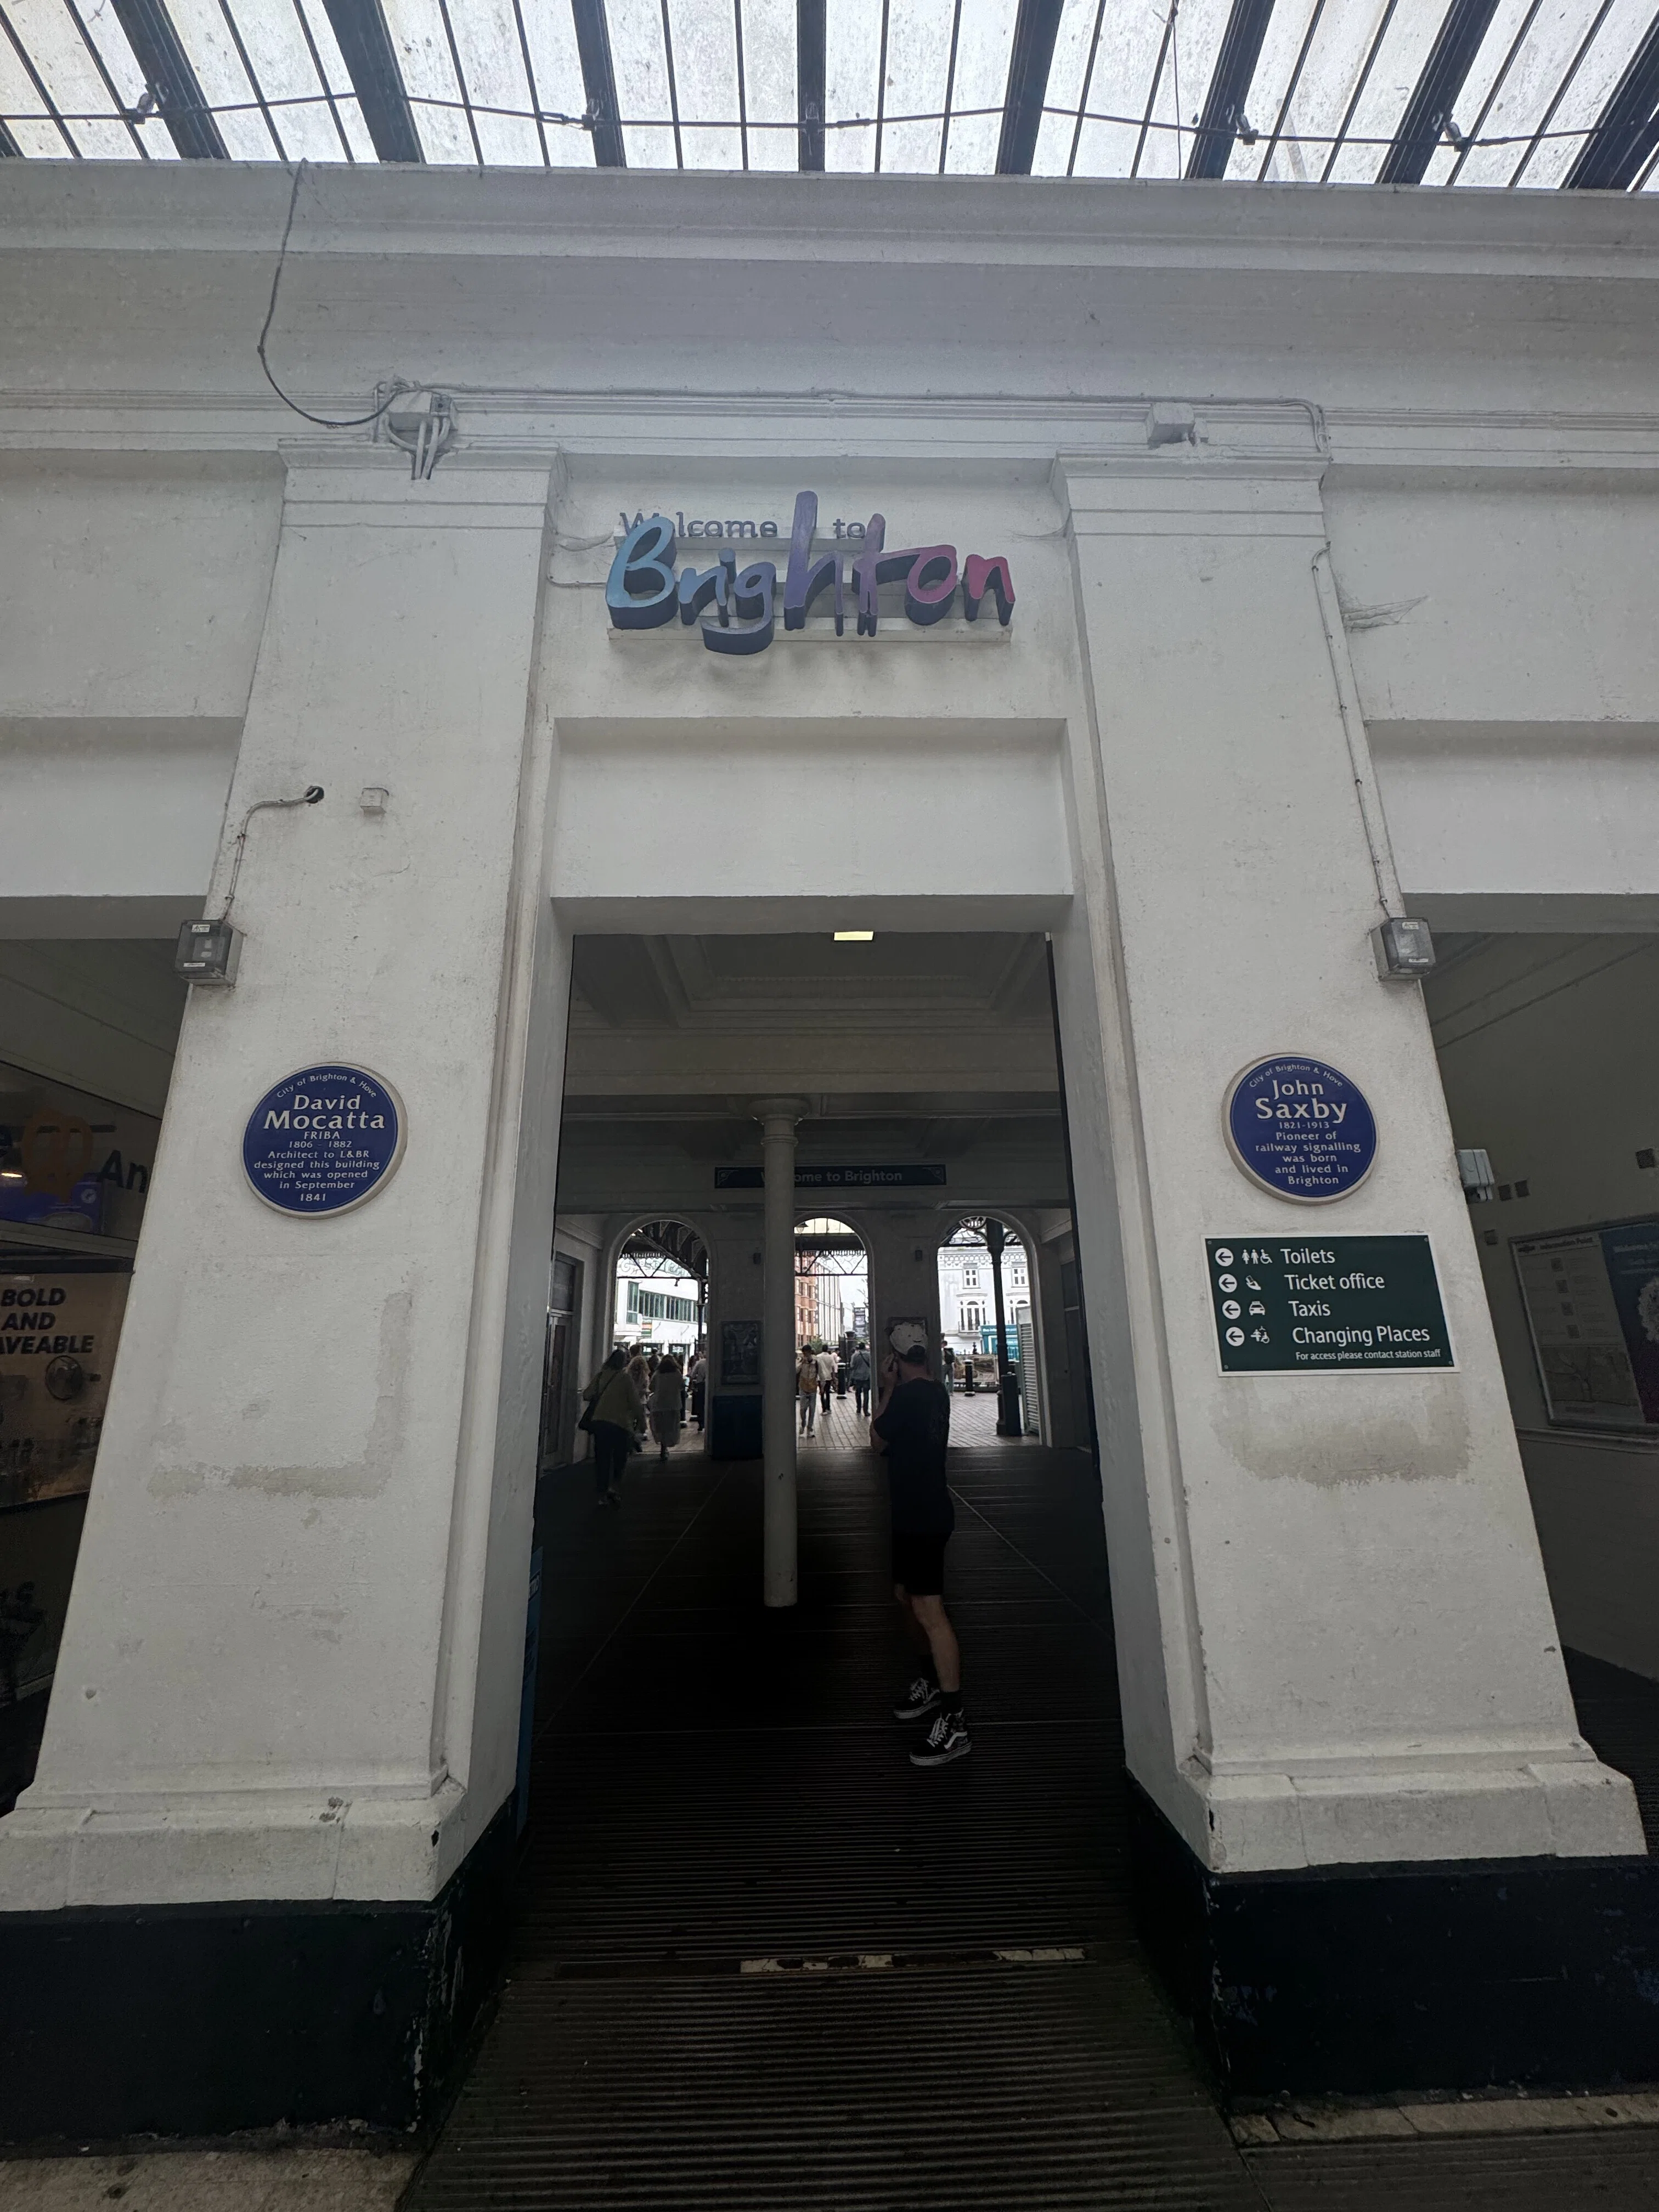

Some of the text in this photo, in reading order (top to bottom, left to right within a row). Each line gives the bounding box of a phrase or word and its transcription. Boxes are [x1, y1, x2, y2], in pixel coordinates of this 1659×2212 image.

[620, 512, 866, 539] Wlcome to
[606, 490, 1015, 654] Brighton
[277, 1084, 294, 1098] City
[297, 1078, 306, 1086] of
[310, 1074, 347, 1082] Brighton
[359, 1081, 376, 1097] Hove
[1250, 1075, 1264, 1087] City
[1323, 1071, 1343, 1087] Hove
[1273, 1080, 1324, 1099] John
[294, 1095, 360, 1110] David
[1255, 1098, 1347, 1123] Saxby
[263, 1110, 385, 1129] Mocatta
[1325, 1131, 1337, 1139] of
[1255, 1143, 1361, 1153] railway signalling
[255, 1161, 303, 1170] designed
[336, 1161, 380, 1170] building
[1302, 1165, 1331, 1173] lived
[328, 1171, 368, 1180] opened
[827, 1170, 840, 1182] to
[844, 1170, 902, 1184] Brighton
[1288, 1176, 1339, 1186] Brighton
[295, 1181, 354, 1190] September
[1280, 1248, 1335, 1264] Toilets
[1284, 1273, 1385, 1290] Ticket office
[1, 1288, 66, 1306] BOLD
[1288, 1300, 1331, 1317] Taxis
[1, 1312, 56, 1330] AND
[1292, 1326, 1430, 1347] Changing Places
[1338, 1351, 1363, 1361] please
[1364, 1350, 1393, 1359] contact
[1395, 1350, 1422, 1358] station
[1424, 1349, 1441, 1357] staff
